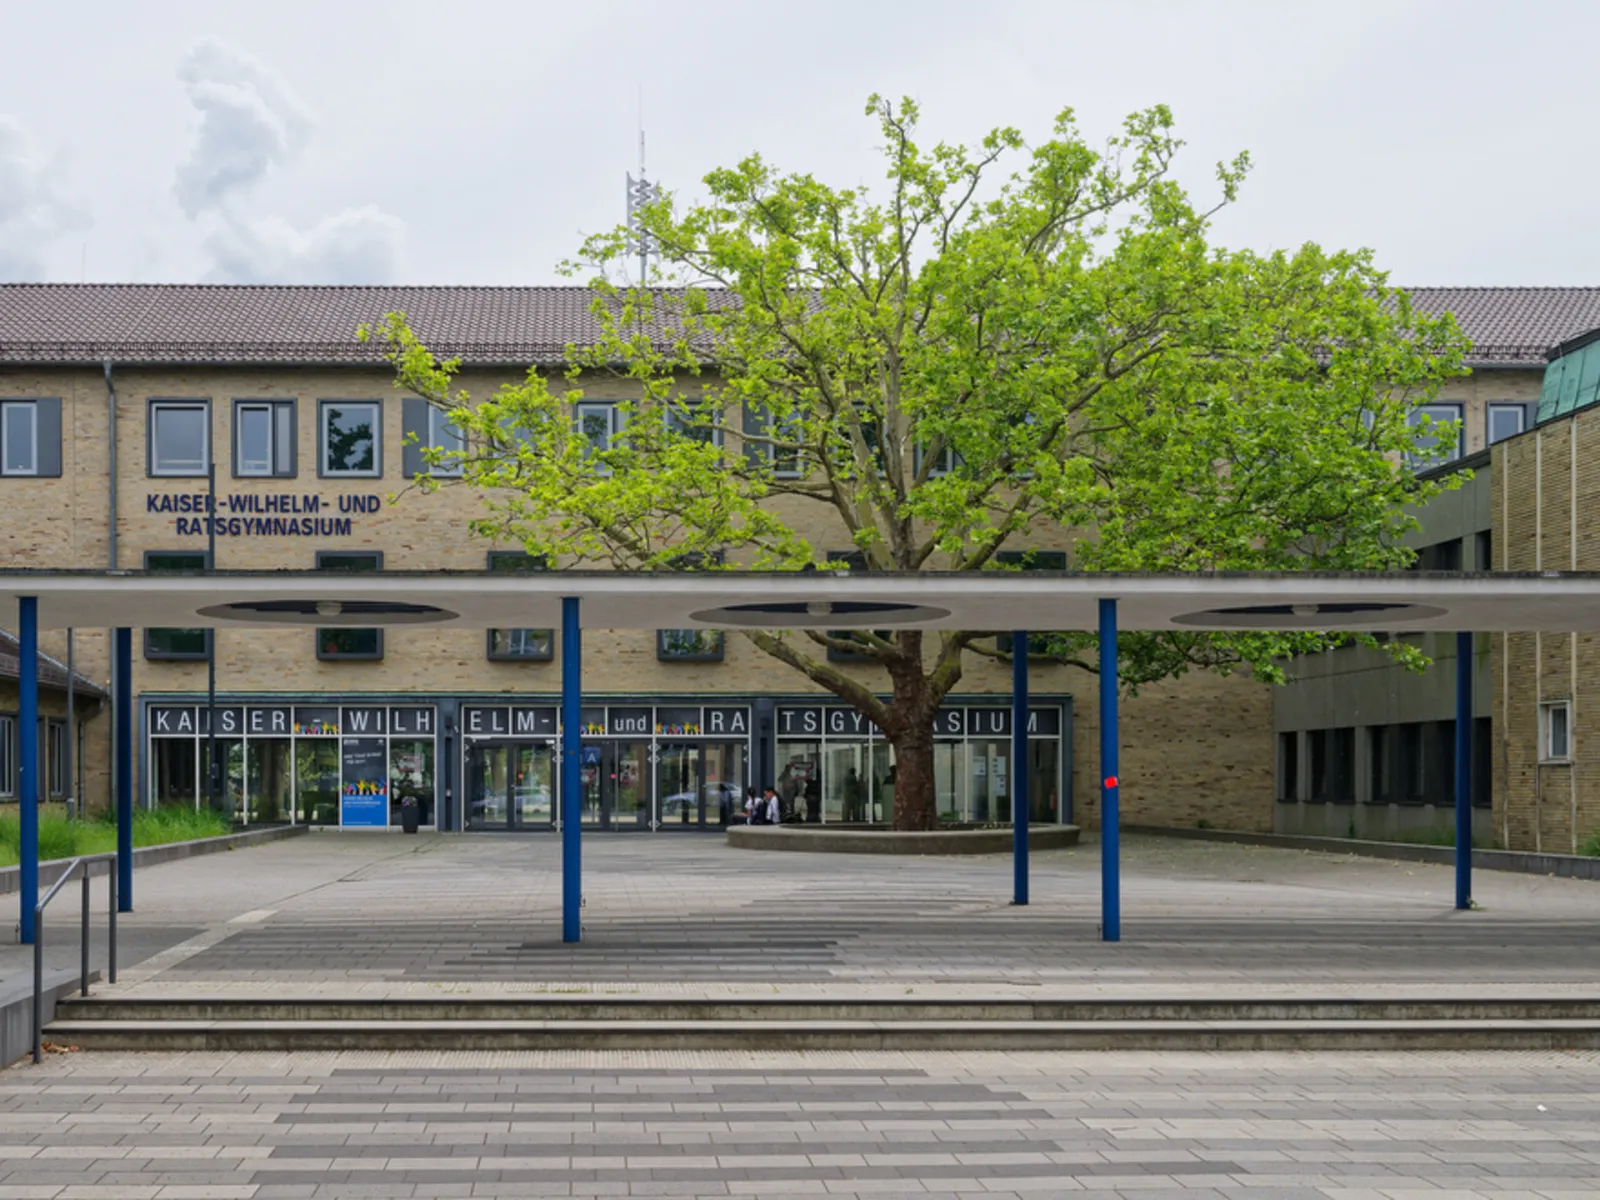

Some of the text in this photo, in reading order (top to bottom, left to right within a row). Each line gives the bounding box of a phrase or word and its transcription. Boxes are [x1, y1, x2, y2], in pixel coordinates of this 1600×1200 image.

[339, 495, 380, 513] UND
[176, 517, 351, 536] RATSGYMNASIUM
[614, 716, 646, 732] und
